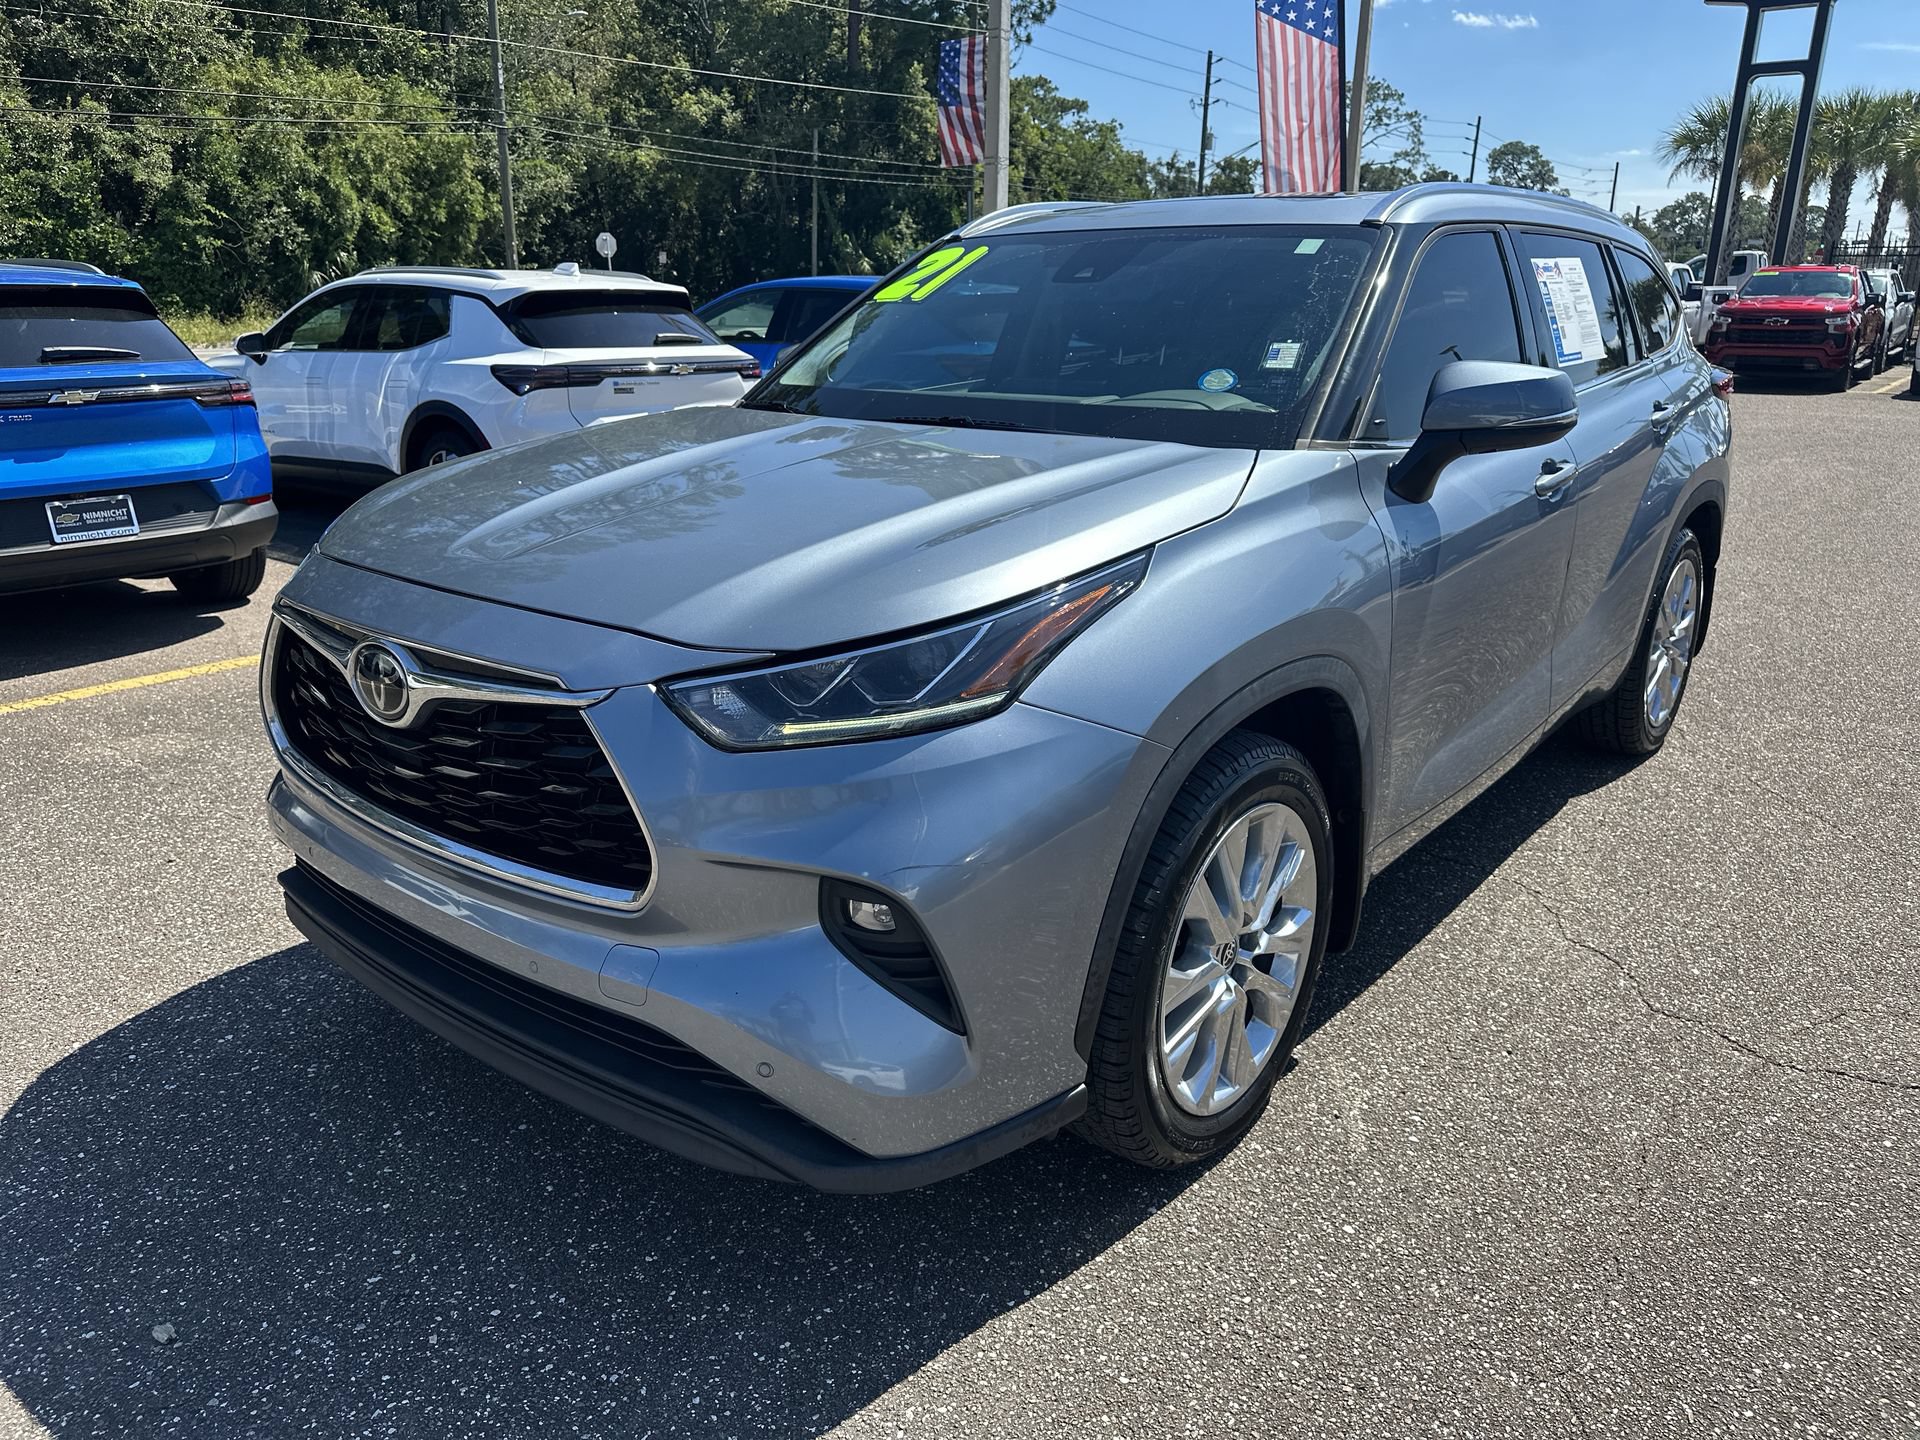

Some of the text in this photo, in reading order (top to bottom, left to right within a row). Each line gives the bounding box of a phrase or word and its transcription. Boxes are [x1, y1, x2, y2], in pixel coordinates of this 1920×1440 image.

[873, 246, 989, 302] 21
[82, 508, 128, 520] NIMNICHT
[60, 528, 134, 542] nimnicht.com
